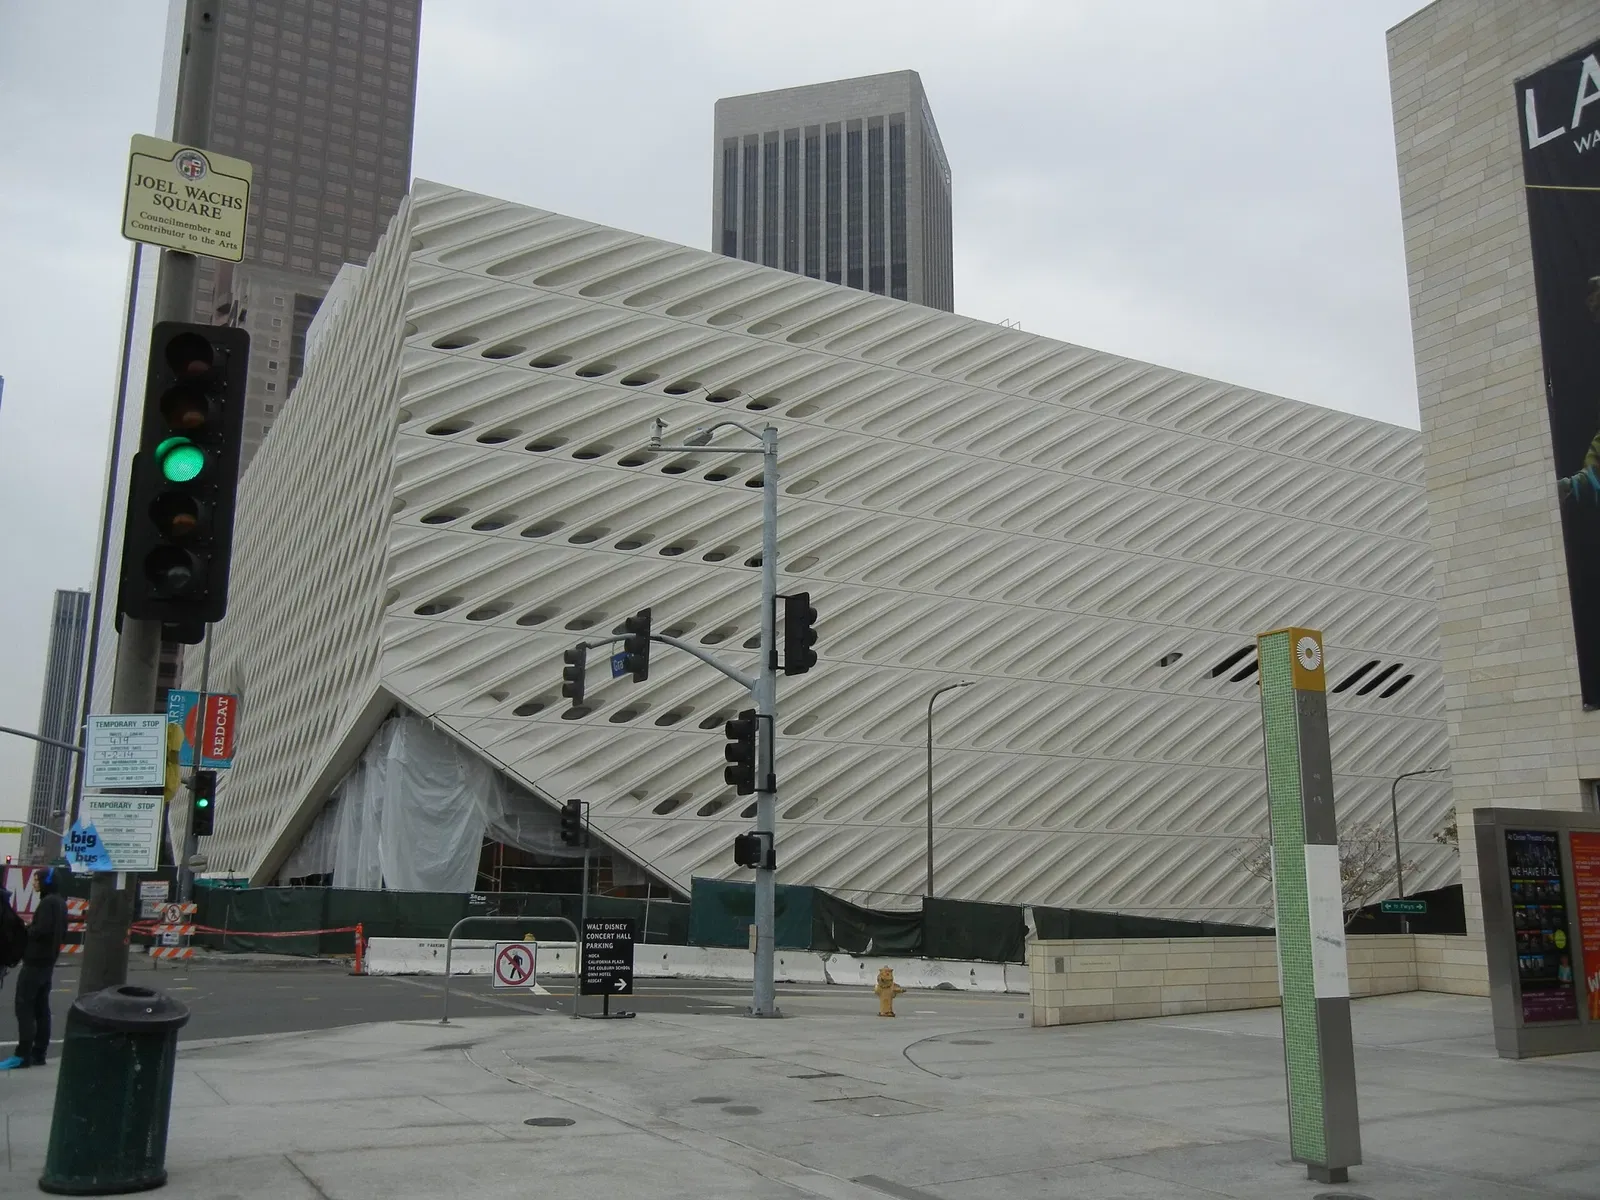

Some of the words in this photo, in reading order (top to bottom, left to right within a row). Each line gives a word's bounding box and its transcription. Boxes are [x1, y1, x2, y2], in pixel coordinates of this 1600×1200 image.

[134, 173, 178, 195] JOEL
[184, 185, 243, 210] WACHS
[152, 193, 222, 220] SQUARE
[131, 220, 185, 239] Contributor
[188, 233, 198, 241] to
[201, 235, 216, 245] the
[218, 240, 238, 250] Arts
[139, 211, 212, 234] Councilmember
[214, 229, 232, 239] and
[95, 720, 138, 728] TEMPORARY
[142, 720, 160, 728] STOP
[213, 697, 229, 756] REDCAT
[89, 800, 133, 809] TEMPORARY
[137, 802, 156, 810] STOP
[64, 844, 87, 852] blue
[70, 831, 97, 848] big
[75, 852, 98, 862] bus
